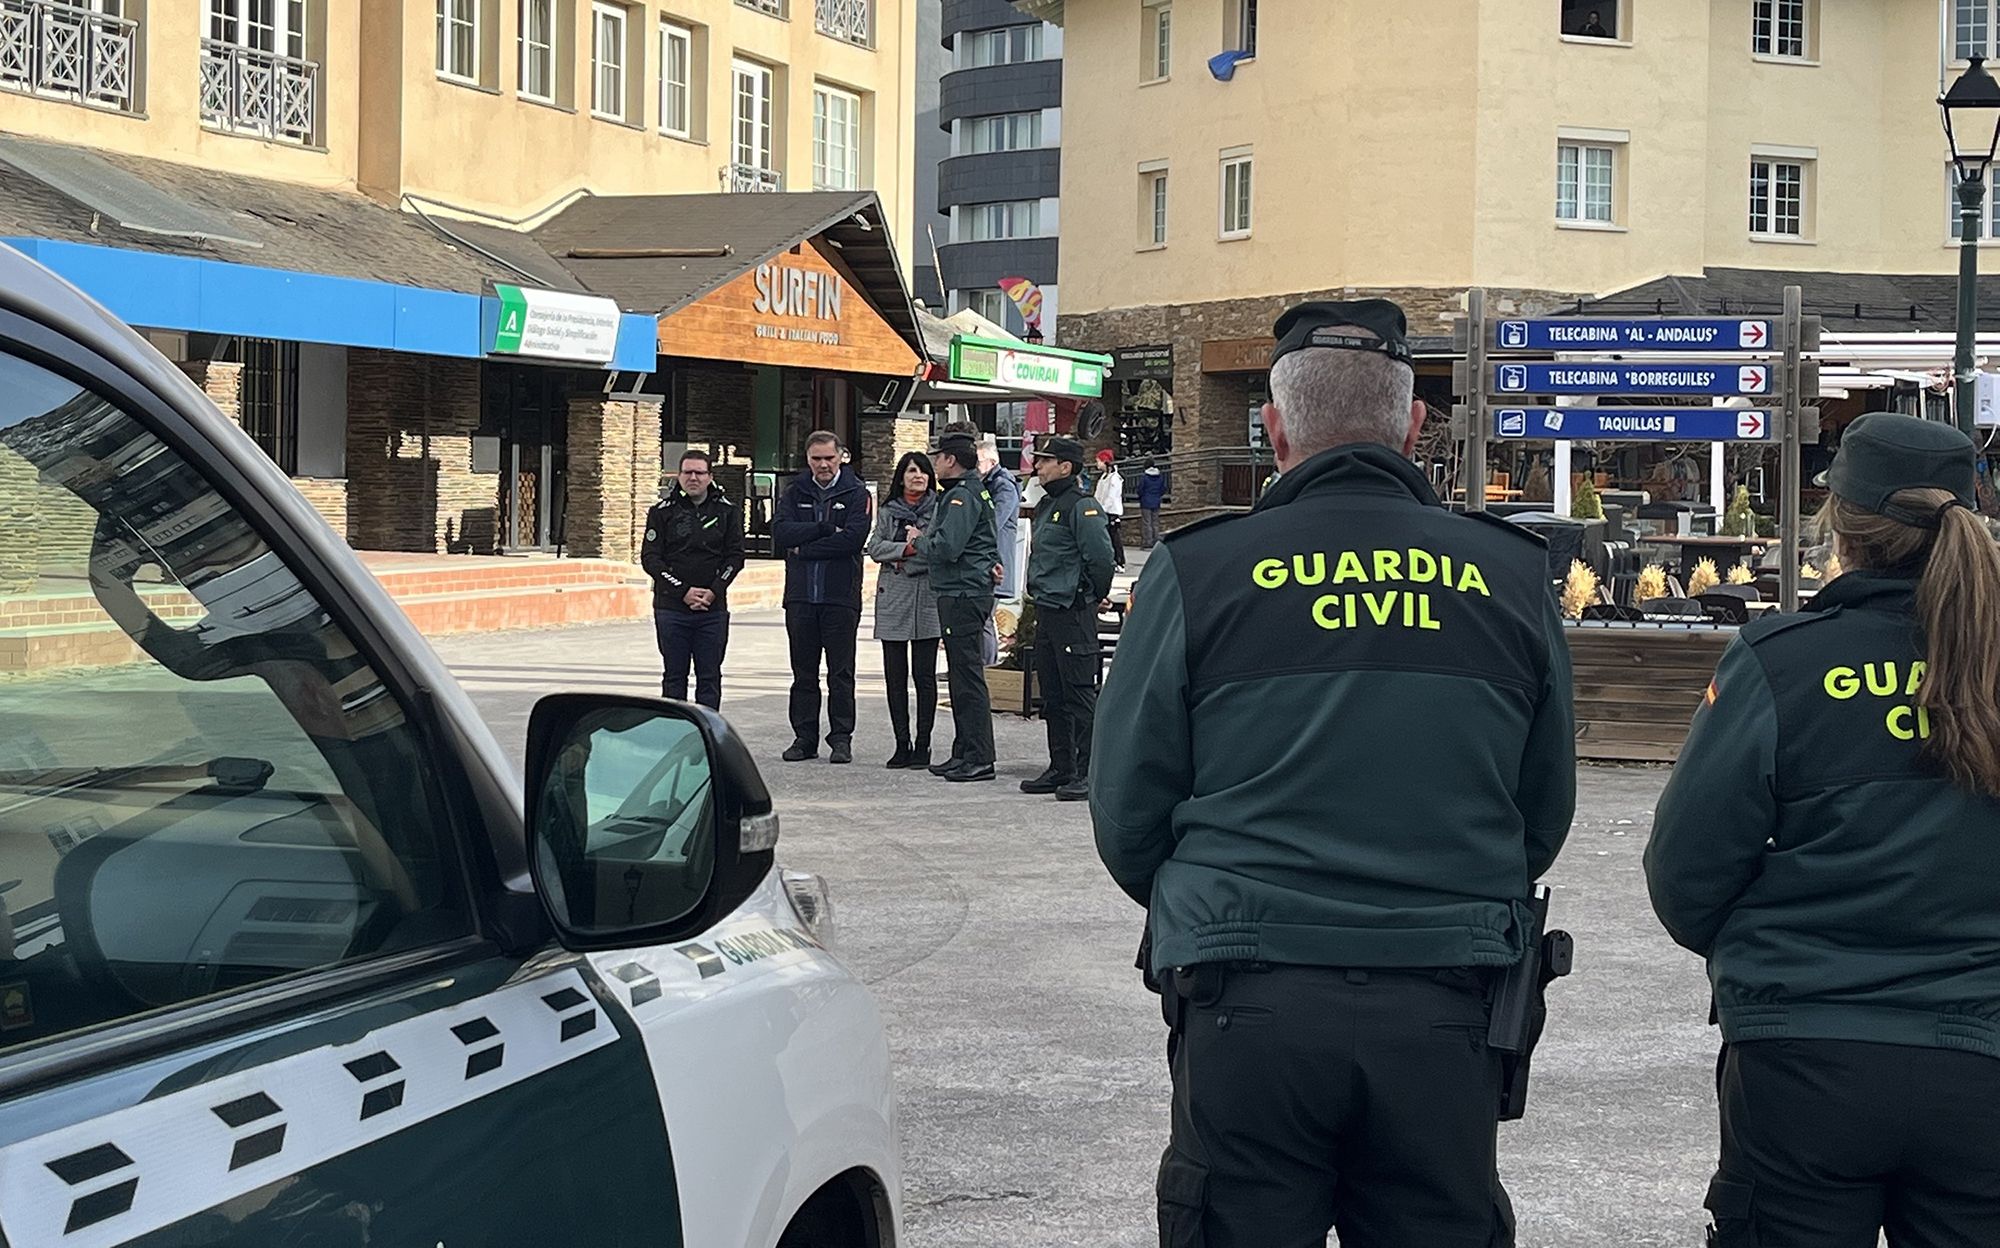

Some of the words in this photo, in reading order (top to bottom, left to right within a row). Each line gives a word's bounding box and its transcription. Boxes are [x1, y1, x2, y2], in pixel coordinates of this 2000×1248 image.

[753, 264, 842, 321] SURFIN
[756, 325, 778, 339] GRILL
[788, 328, 818, 344] ITALIAN
[818, 331, 840, 346] FOOD
[1549, 327, 1619, 342] TELECABINA
[1016, 363, 1059, 383] COVIRAN
[1549, 371, 1619, 385] TELECABINA
[1599, 416, 1662, 431] TAQUILLAS
[1251, 548, 1491, 597] GUARDIA
[1311, 590, 1441, 630] CIVIL
[1823, 660, 1927, 700] GUA
[1886, 705, 1930, 740] CI
[714, 930, 791, 966] GUARDIA
